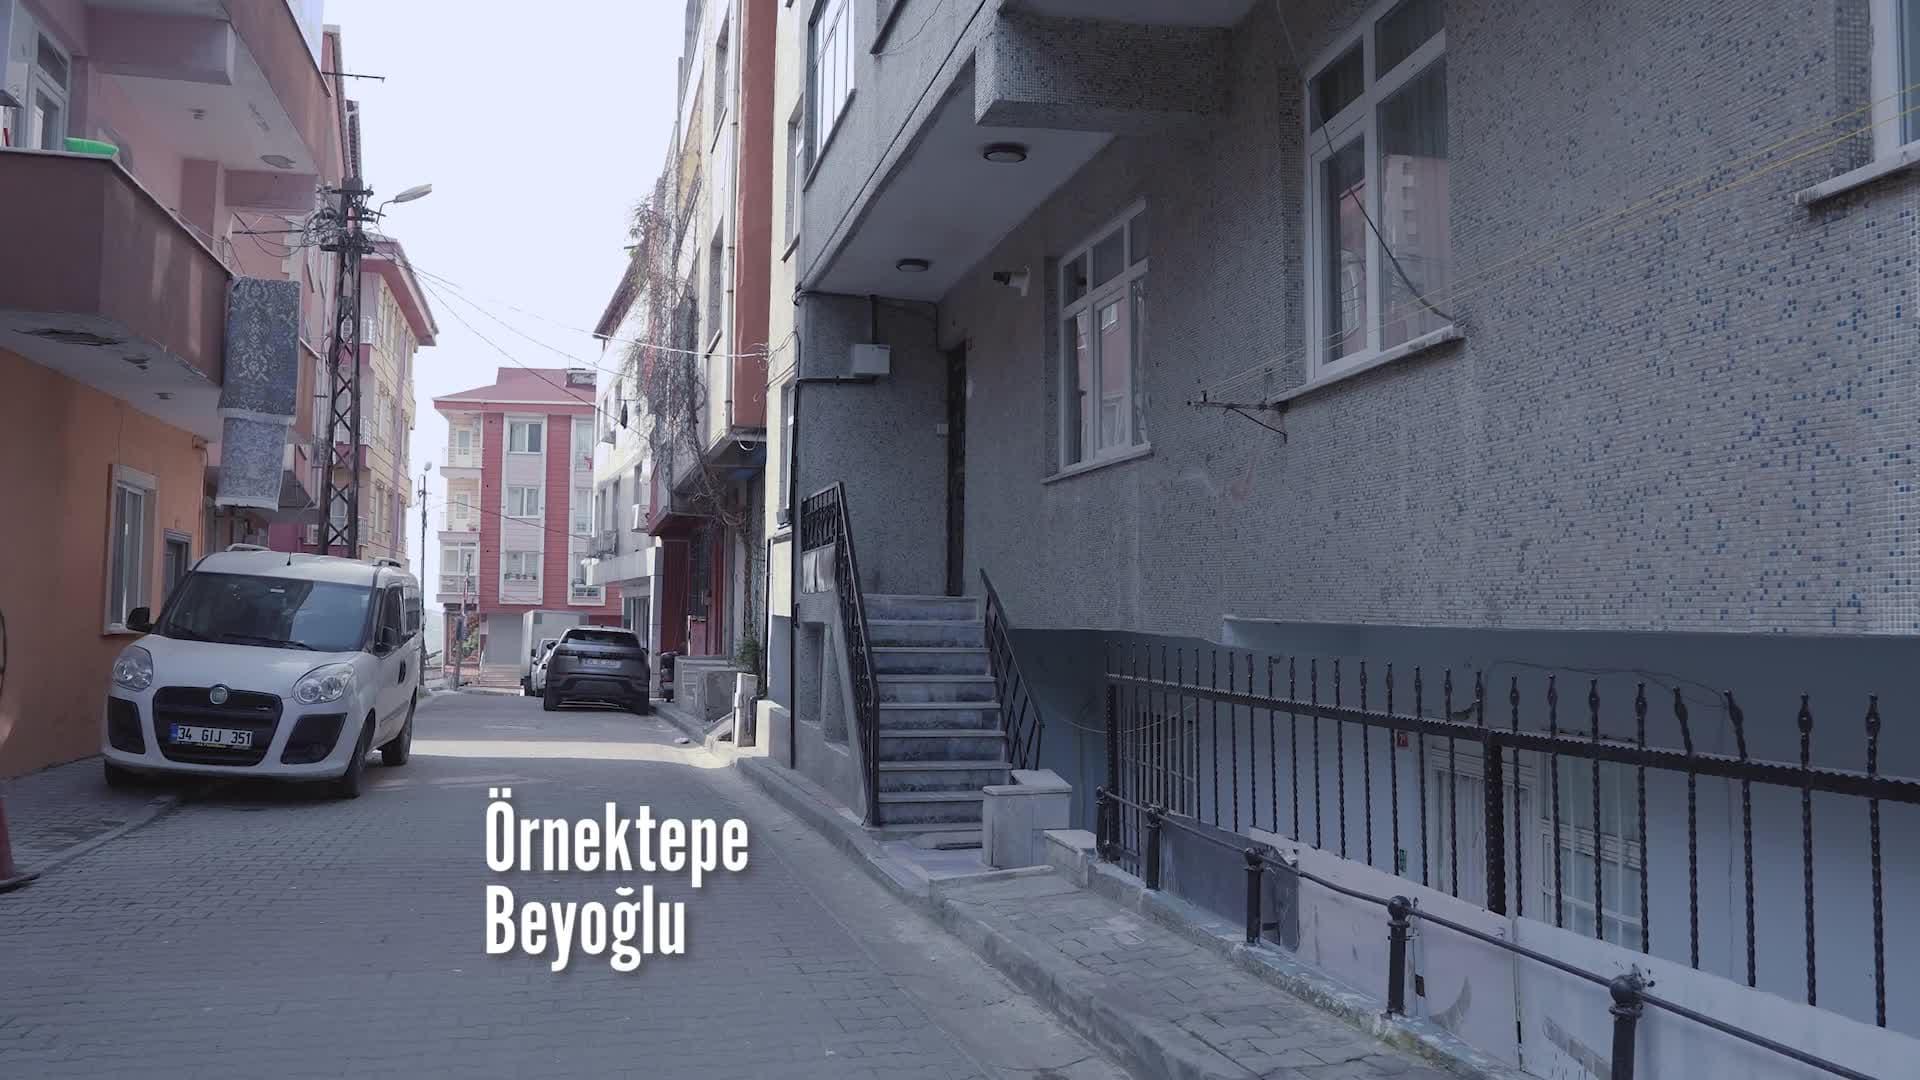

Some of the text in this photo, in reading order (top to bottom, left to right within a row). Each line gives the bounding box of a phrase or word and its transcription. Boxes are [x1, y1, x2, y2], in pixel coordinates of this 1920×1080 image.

[178, 727, 251, 745] 34 GIJ 351
